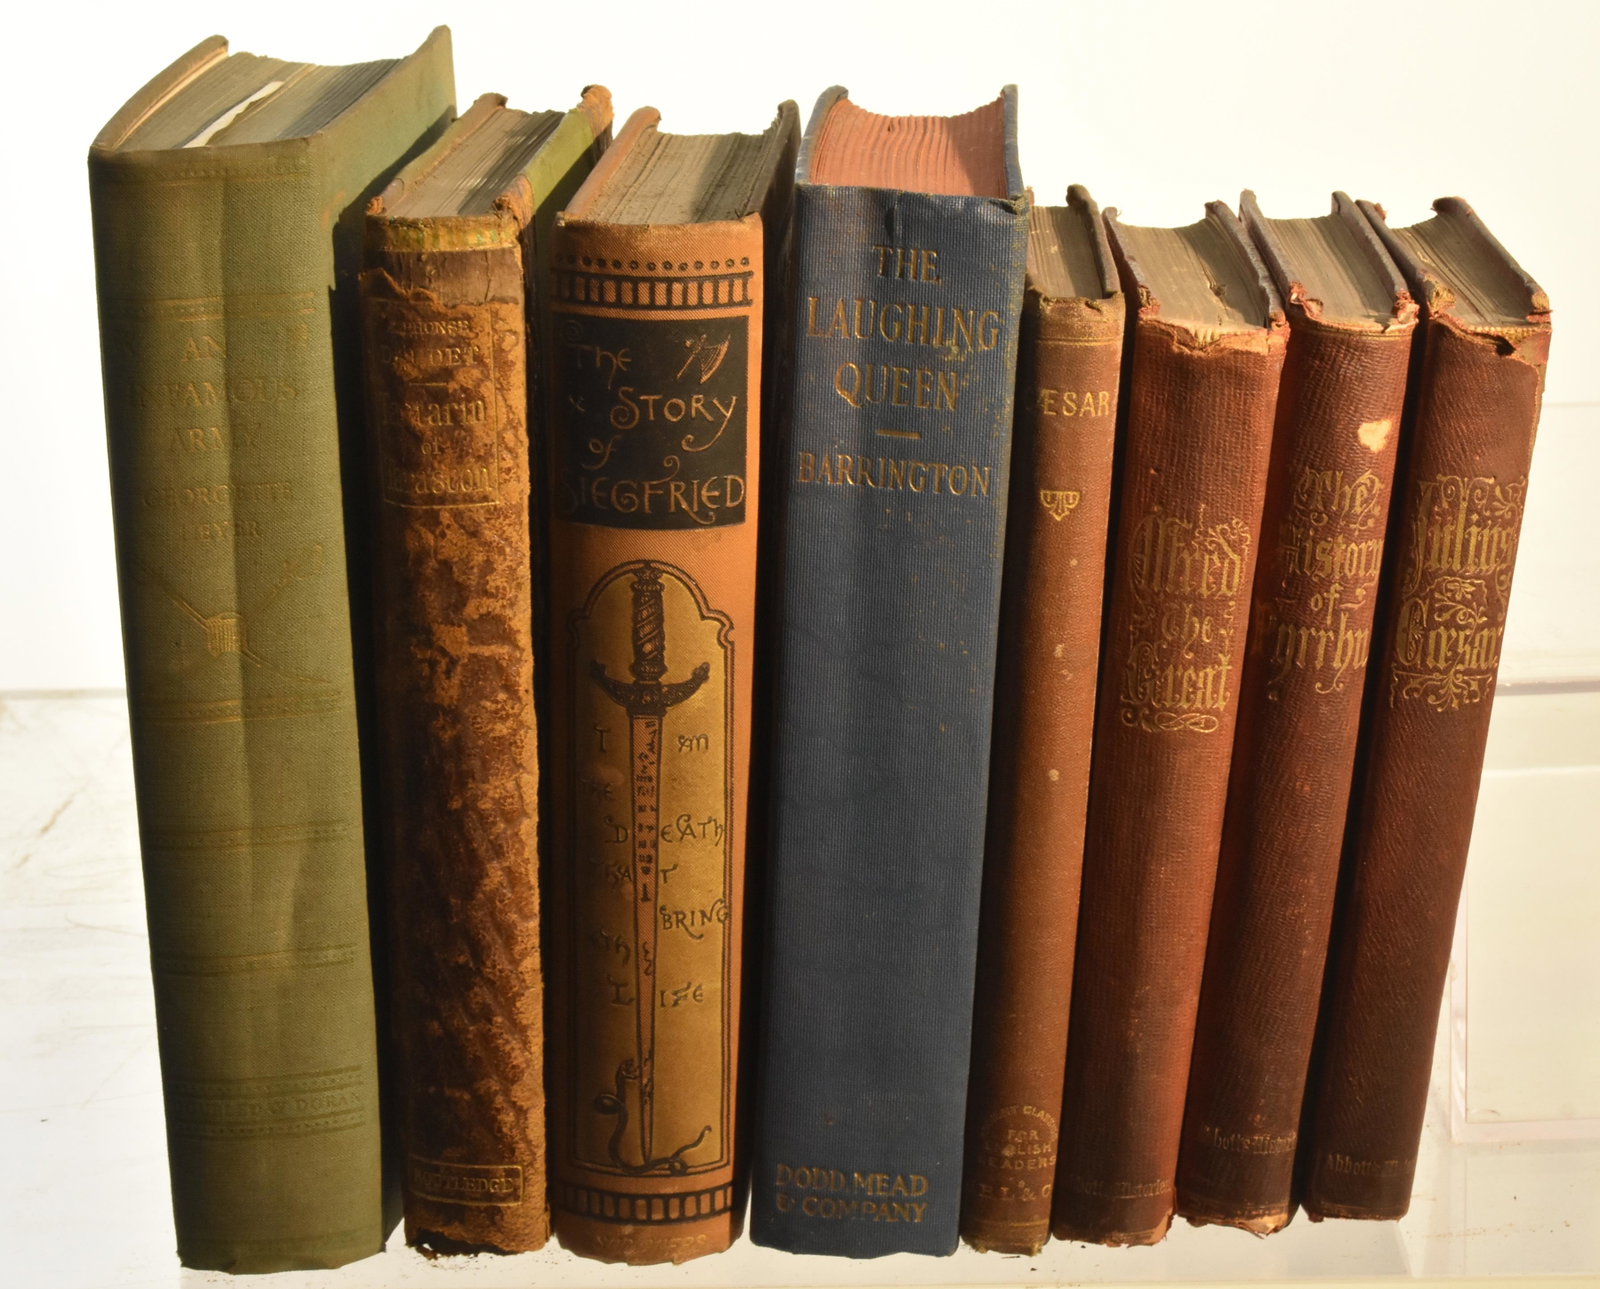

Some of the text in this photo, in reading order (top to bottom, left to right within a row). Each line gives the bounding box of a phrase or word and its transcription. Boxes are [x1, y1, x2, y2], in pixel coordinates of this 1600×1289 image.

[873, 245, 943, 284] THE
[806, 297, 999, 351] LAUGHING
[834, 361, 959, 411] QUEEN
[580, 434, 623, 472] of
[797, 452, 993, 498] BARRINGTON
[1310, 583, 1343, 627] of
[853, 1172, 930, 1197] MEAD
[802, 1195, 928, 1224] COMPANY
